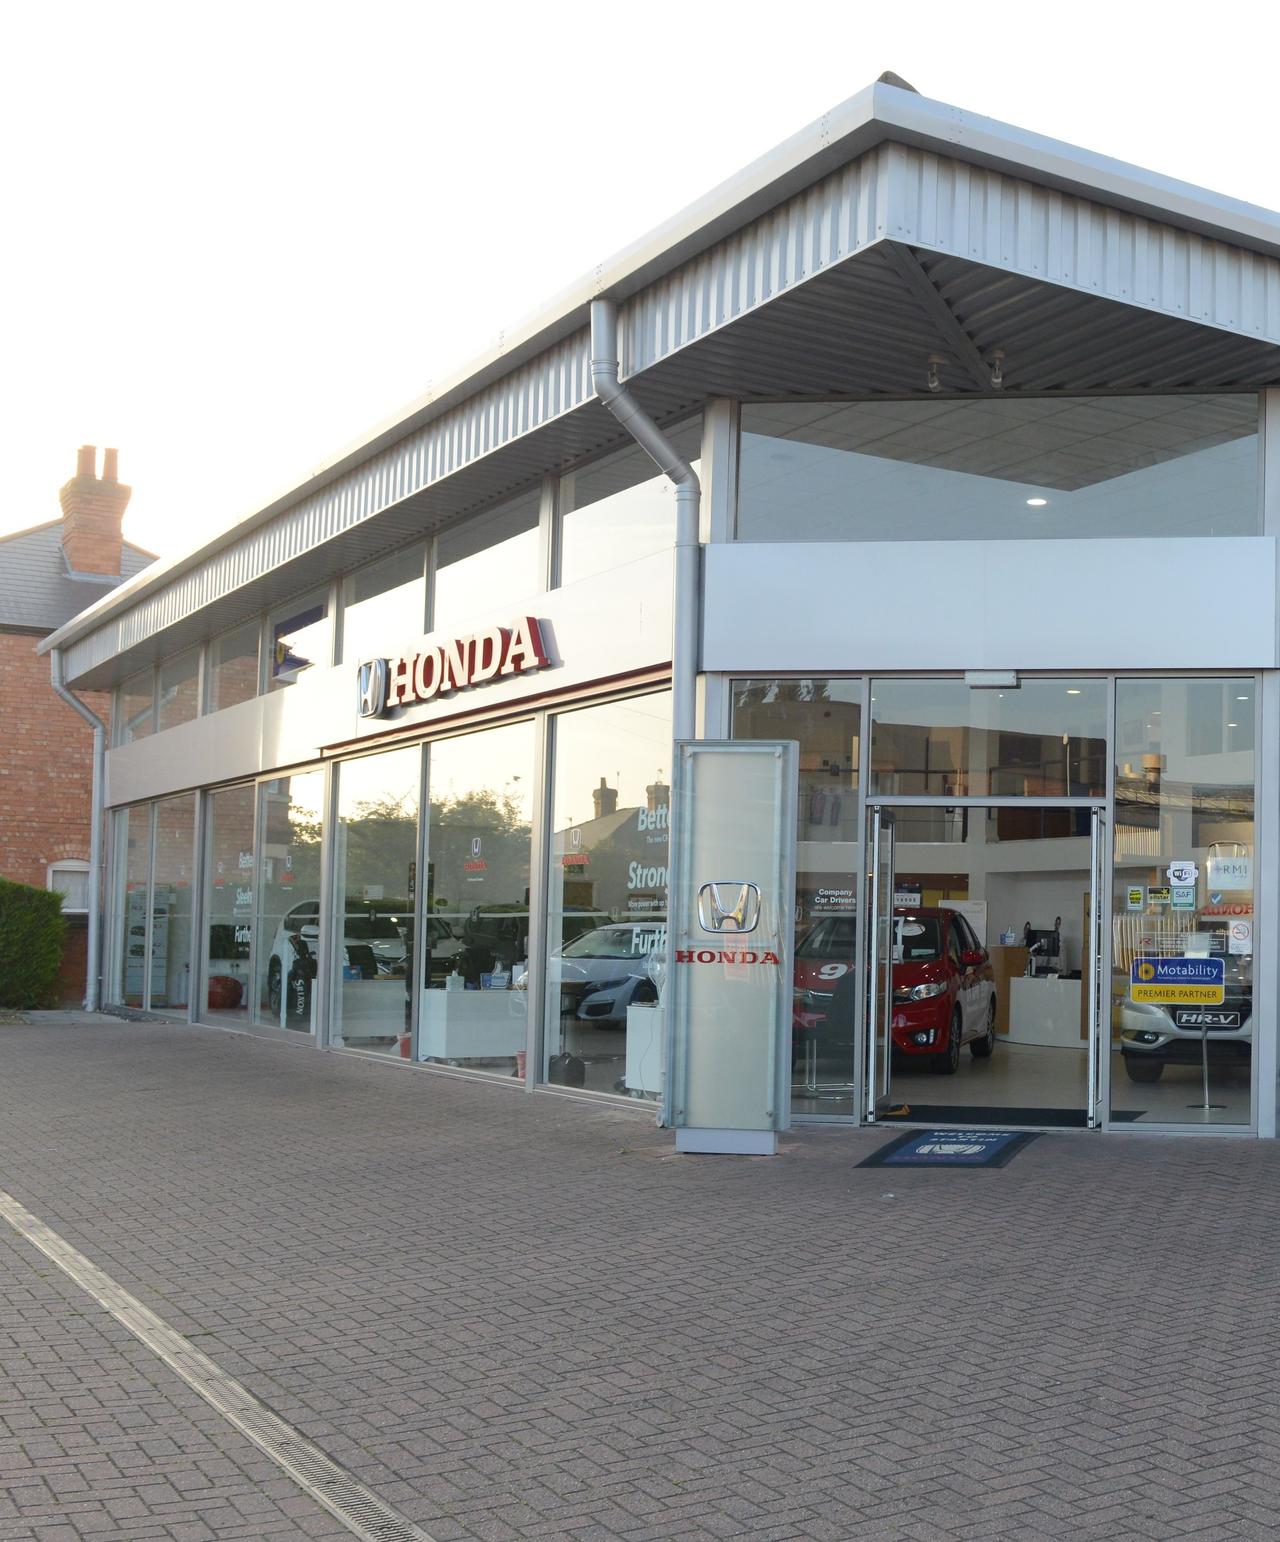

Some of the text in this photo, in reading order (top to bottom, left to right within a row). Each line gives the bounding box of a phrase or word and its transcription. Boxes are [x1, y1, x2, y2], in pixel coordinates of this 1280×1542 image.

[387, 616, 549, 708] HONDA
[1223, 865, 1248, 874] RMI
[818, 888, 853, 897] Company
[815, 896, 856, 904] Car Drivers
[675, 950, 780, 965] HONDA
[1157, 964, 1219, 978] Motability
[1137, 990, 1217, 998] PREMIER PARTNER
[1180, 1014, 1236, 1024] HR-V
